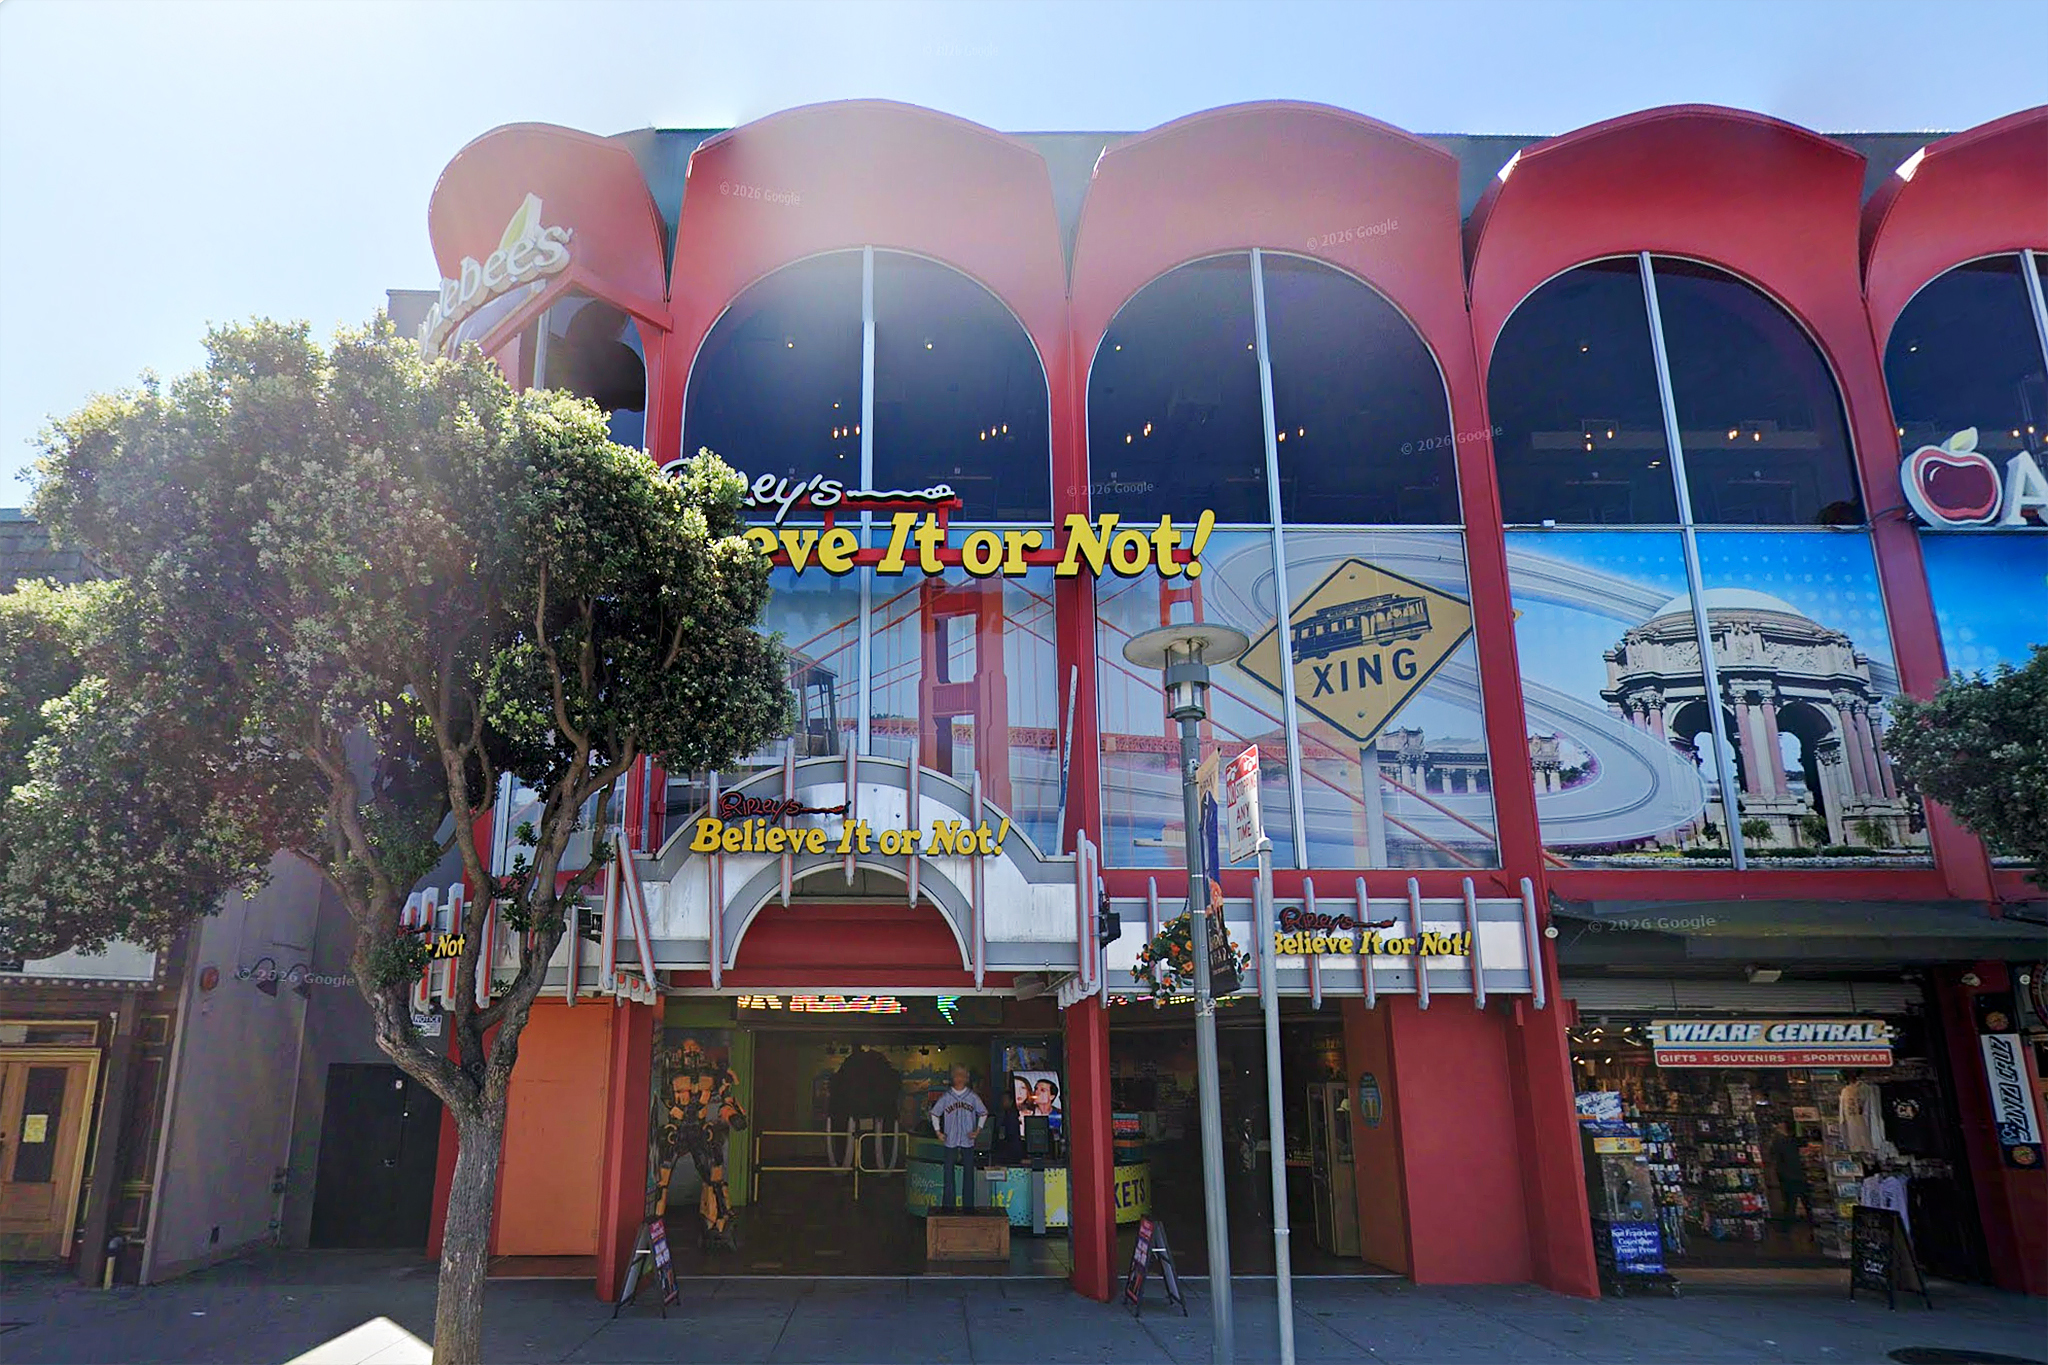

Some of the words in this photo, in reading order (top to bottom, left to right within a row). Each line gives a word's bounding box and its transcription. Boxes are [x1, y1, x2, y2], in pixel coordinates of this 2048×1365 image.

[876, 512, 946, 577] It
[962, 529, 1043, 577] or
[1054, 509, 1216, 578] Not!
[1312, 648, 1418, 698] XING
[1236, 801, 1250, 824] ANY
[689, 817, 828, 855] Believe
[835, 818, 872, 855] It
[879, 829, 922, 856] or
[926, 817, 1010, 856] Not!
[1237, 820, 1251, 842] TIME
[434, 933, 466, 959] Not
[1359, 930, 1384, 955] It
[1386, 937, 1415, 955] or
[1419, 930, 1472, 956] Not!
[1666, 1023, 1764, 1042] WHARF
[1765, 1024, 1878, 1043] CENTRAL
[1660, 1054, 1697, 1063] GIFTS
[1713, 1053, 1786, 1063] SOUVENIRS
[1803, 1053, 1888, 1063] SPORTSWEAR
[1114, 1177, 1146, 1209] KETS
